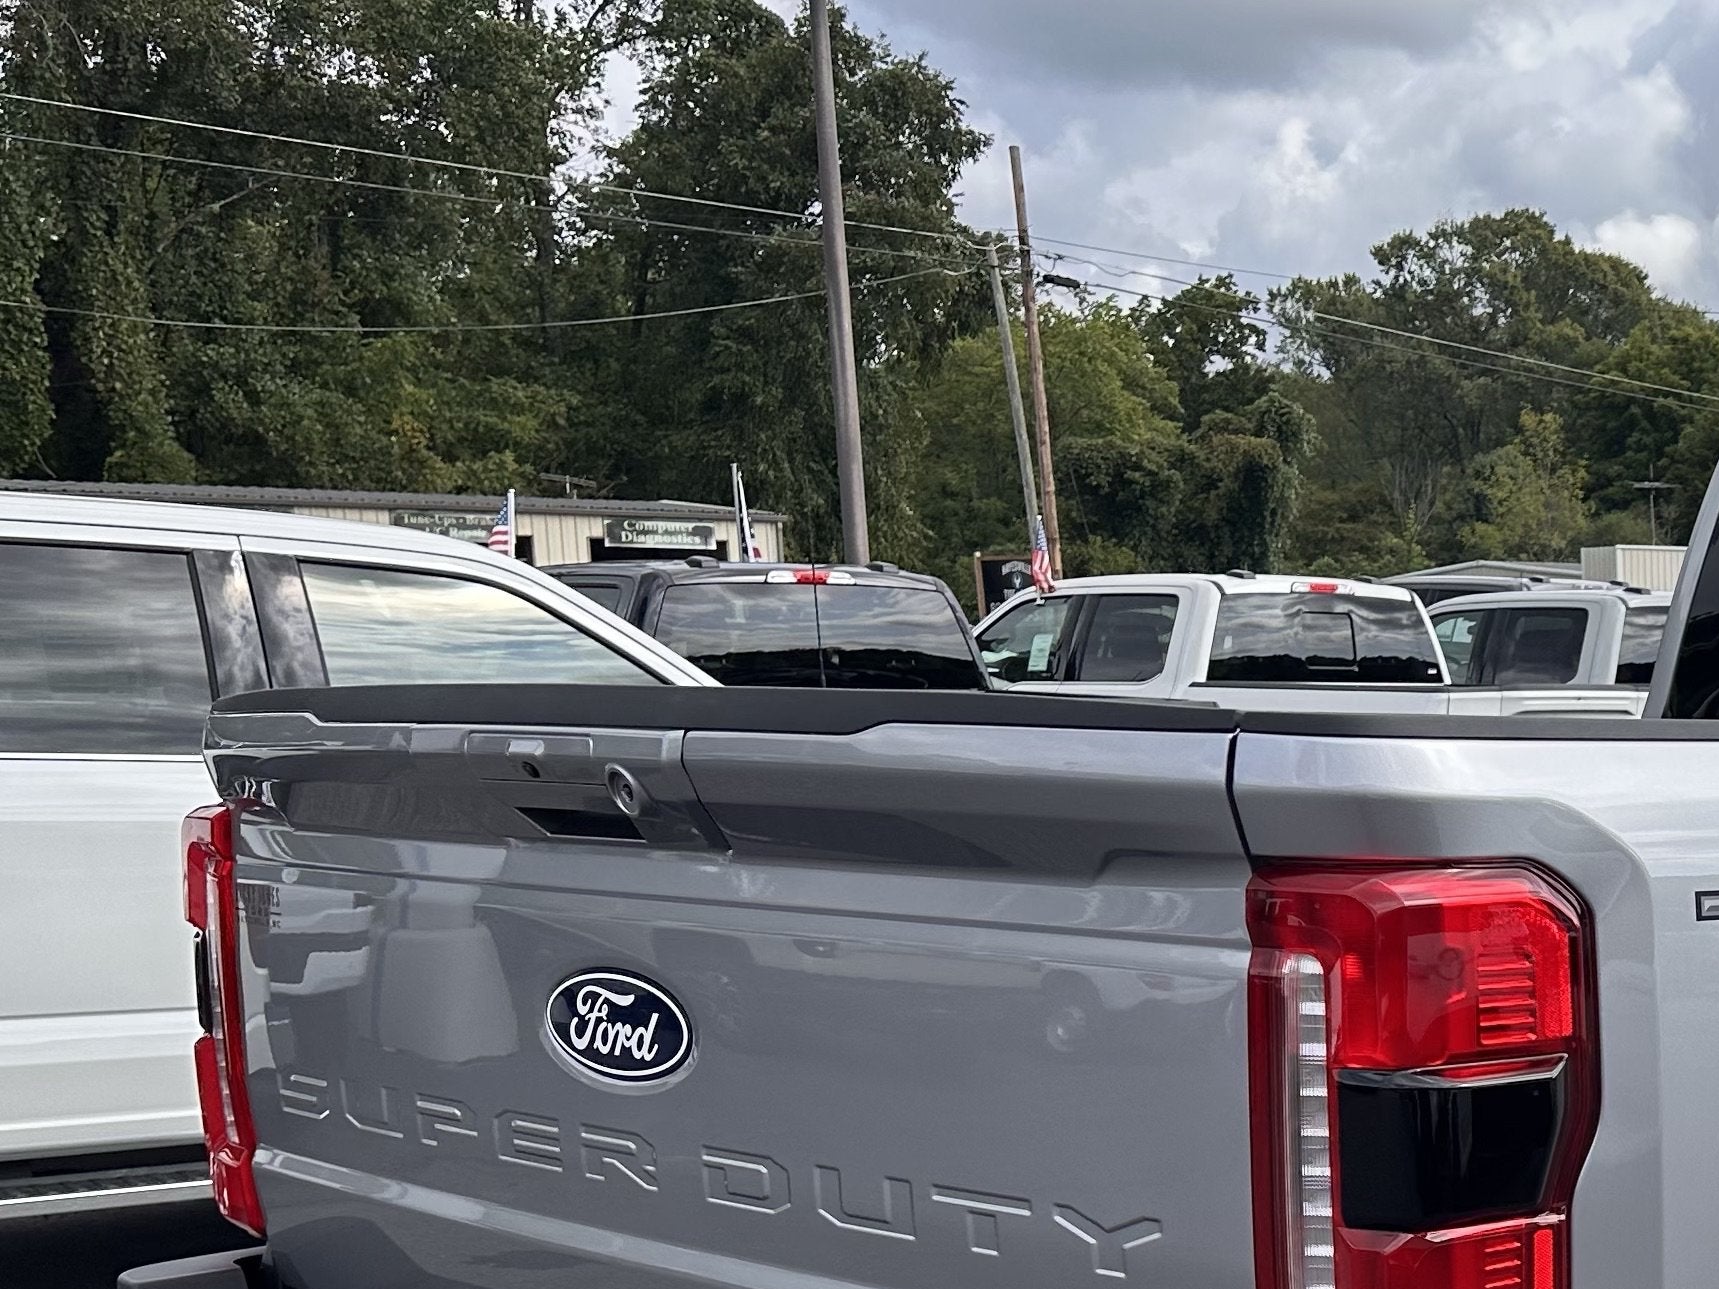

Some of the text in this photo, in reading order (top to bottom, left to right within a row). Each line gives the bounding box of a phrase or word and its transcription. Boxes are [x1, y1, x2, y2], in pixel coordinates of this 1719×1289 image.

[620, 530, 701, 545] Diagnostics
[623, 519, 693, 534] Computer
[570, 983, 660, 1062] Ford
[278, 1068, 1164, 1280] SUPER DUTY
